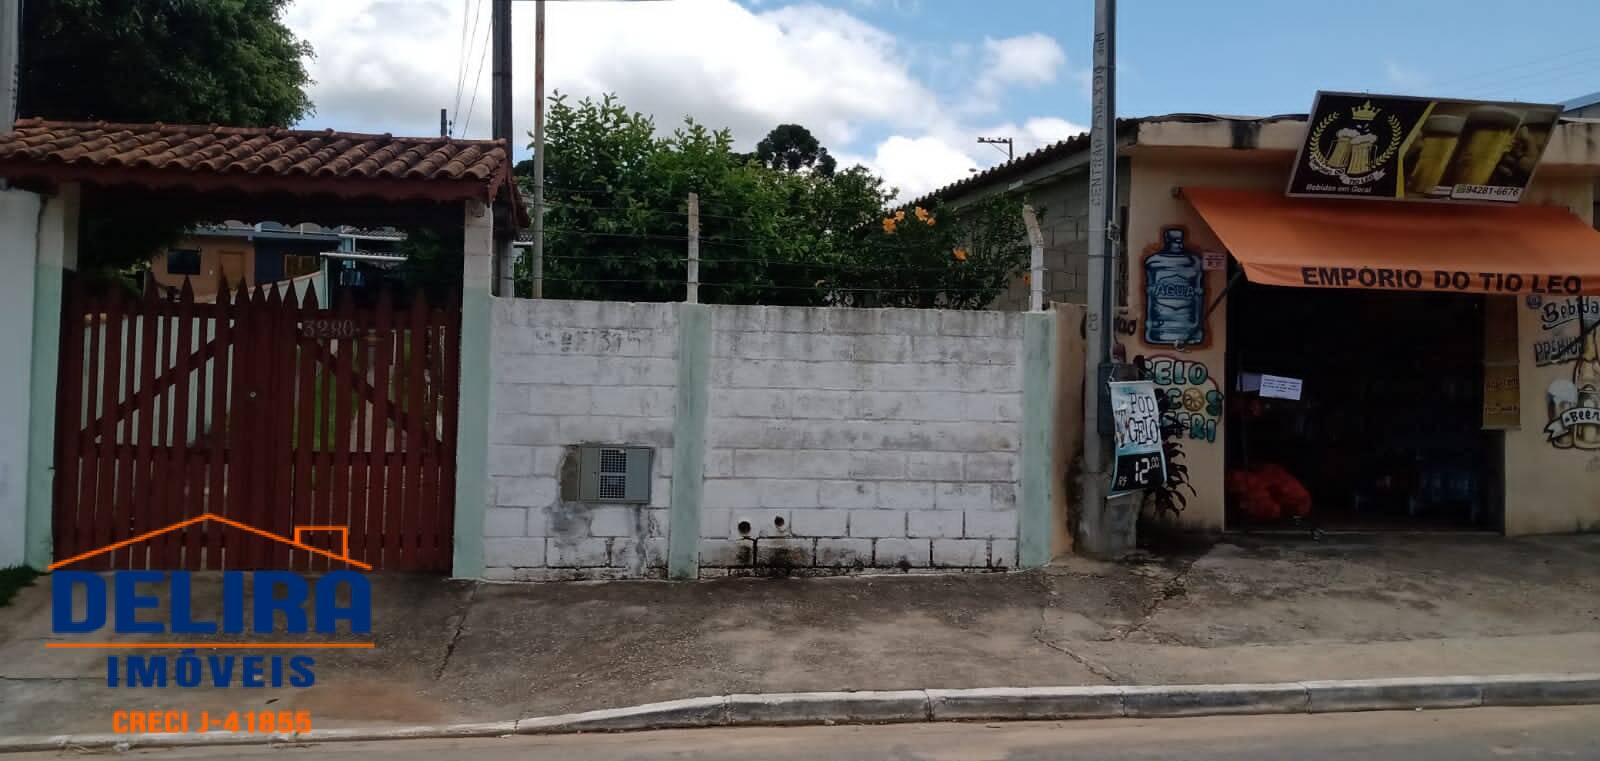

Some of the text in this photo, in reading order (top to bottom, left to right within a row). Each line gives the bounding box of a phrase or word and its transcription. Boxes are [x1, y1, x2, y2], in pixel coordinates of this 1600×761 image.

[1306, 183, 1336, 192] Bebidas
[1466, 185, 1519, 197] 94281-6676
[1301, 265, 1583, 295] EMPÓRIO DO TIO LEO
[1128, 417, 1159, 444] GELO
